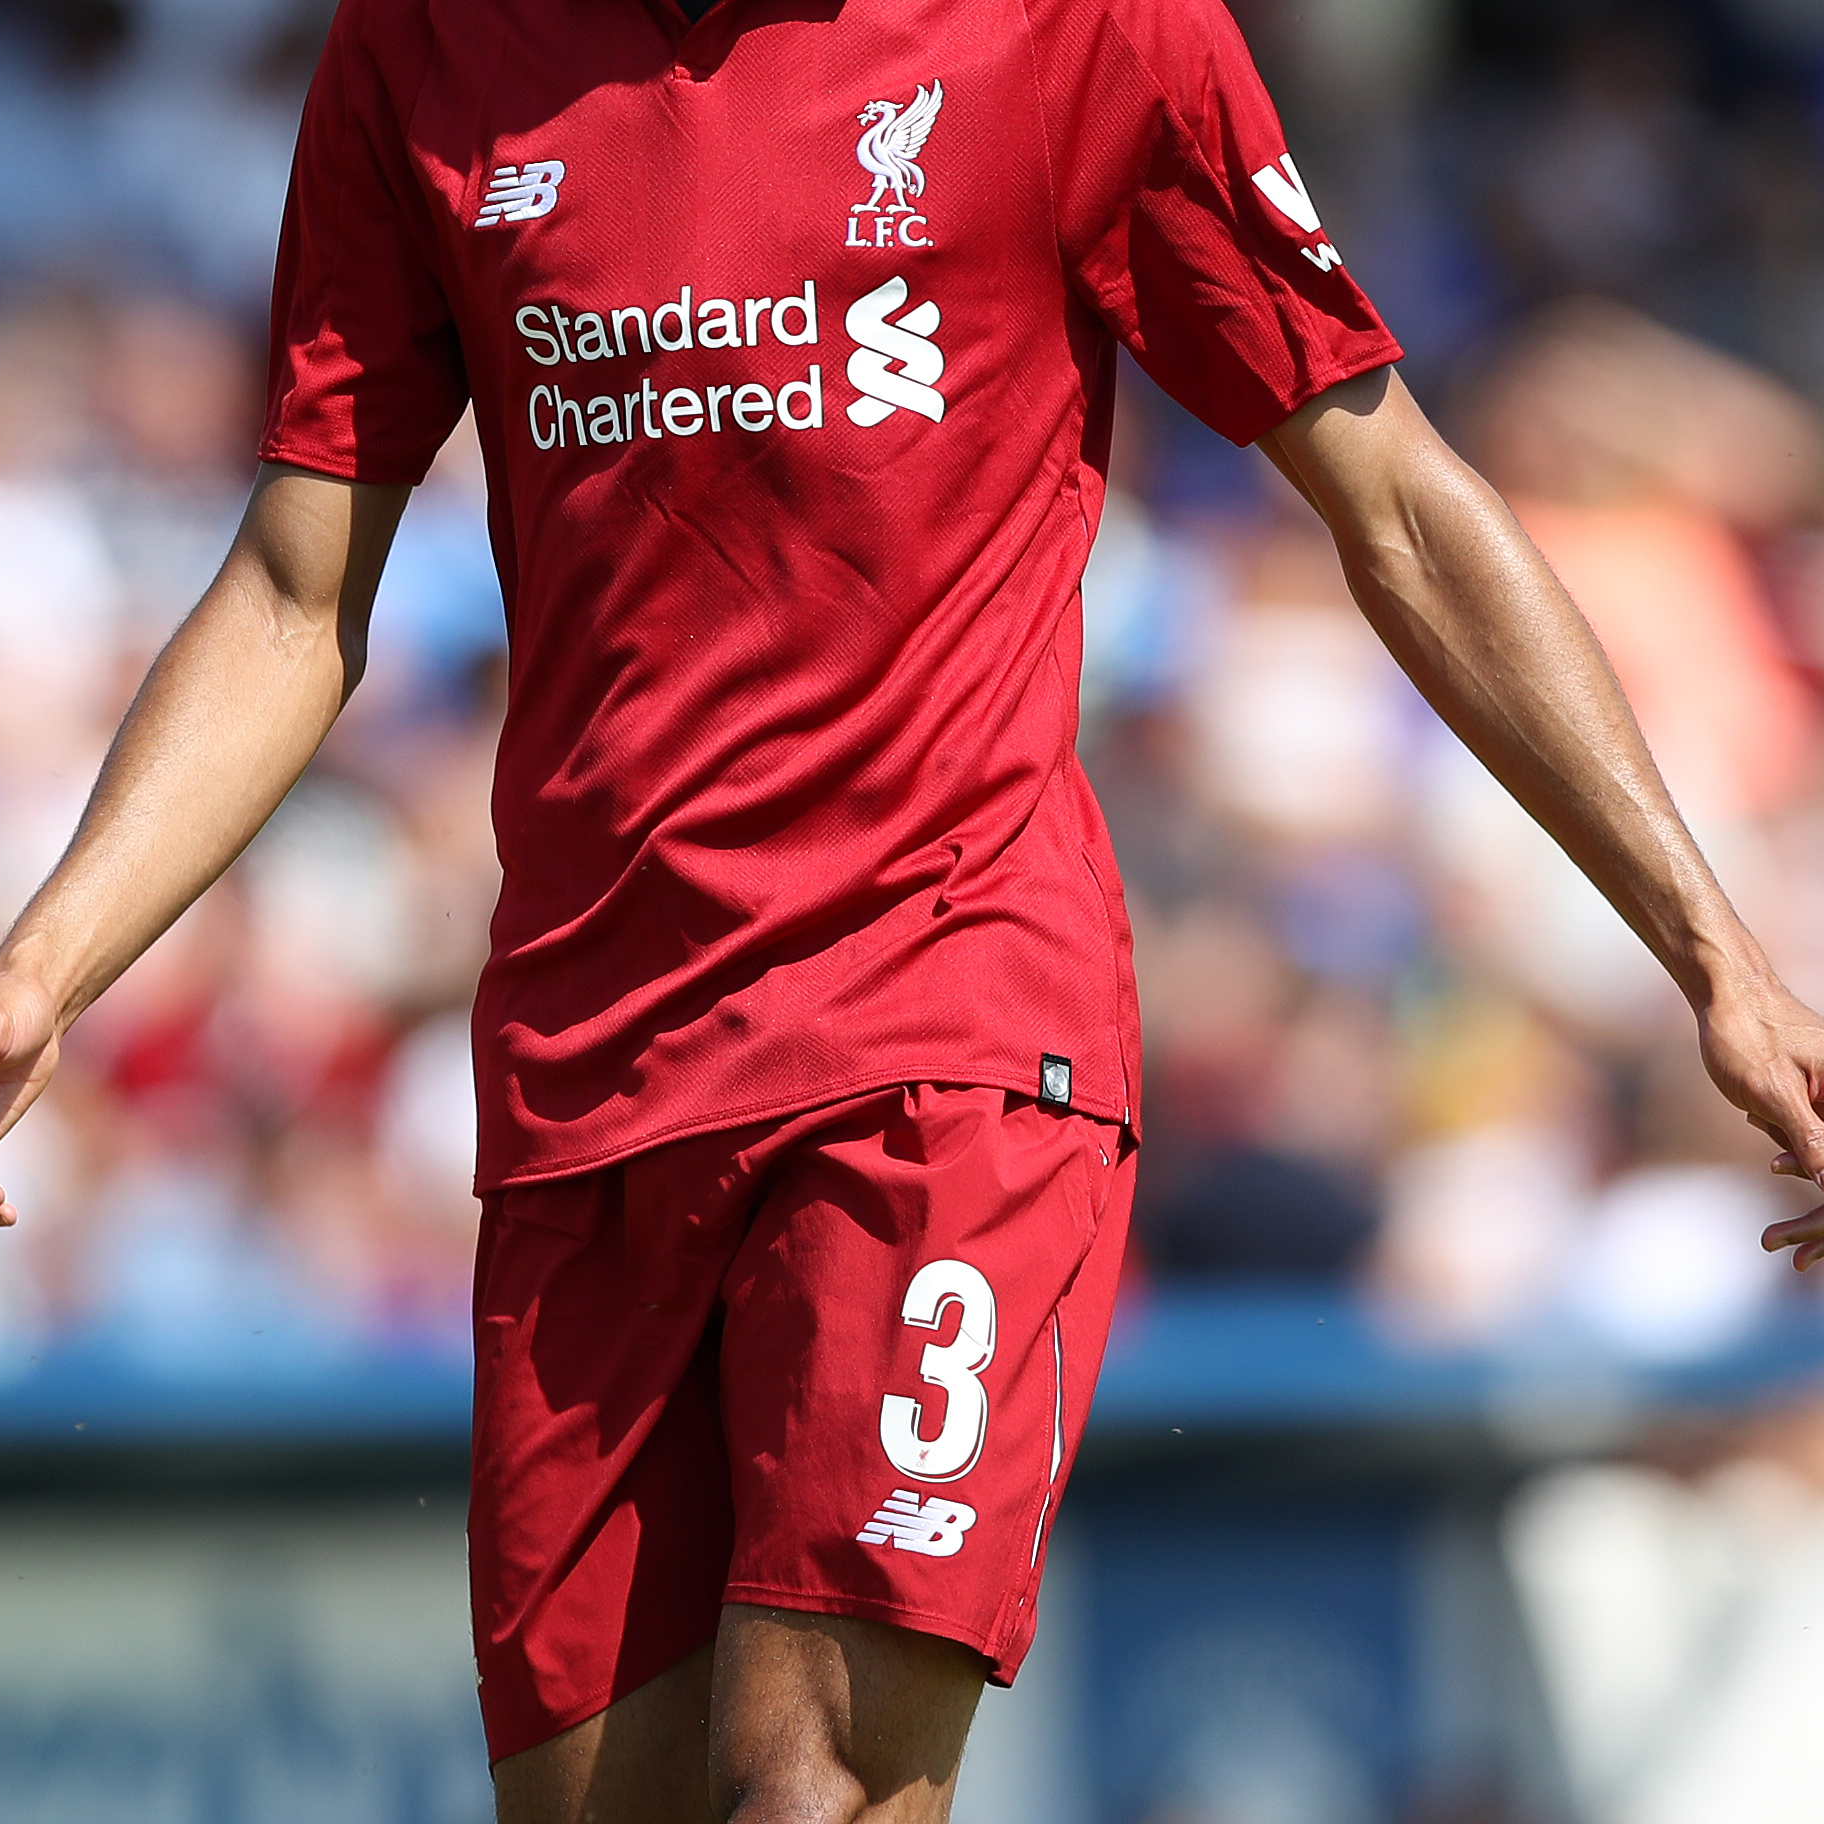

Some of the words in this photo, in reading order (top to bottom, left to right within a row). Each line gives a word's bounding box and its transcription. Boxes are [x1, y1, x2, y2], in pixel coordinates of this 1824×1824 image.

[845, 215, 934, 247] L.F.C.
[515, 280, 818, 366] Standard
[529, 364, 824, 450] Chartered
[879, 1258, 997, 1482] 3
